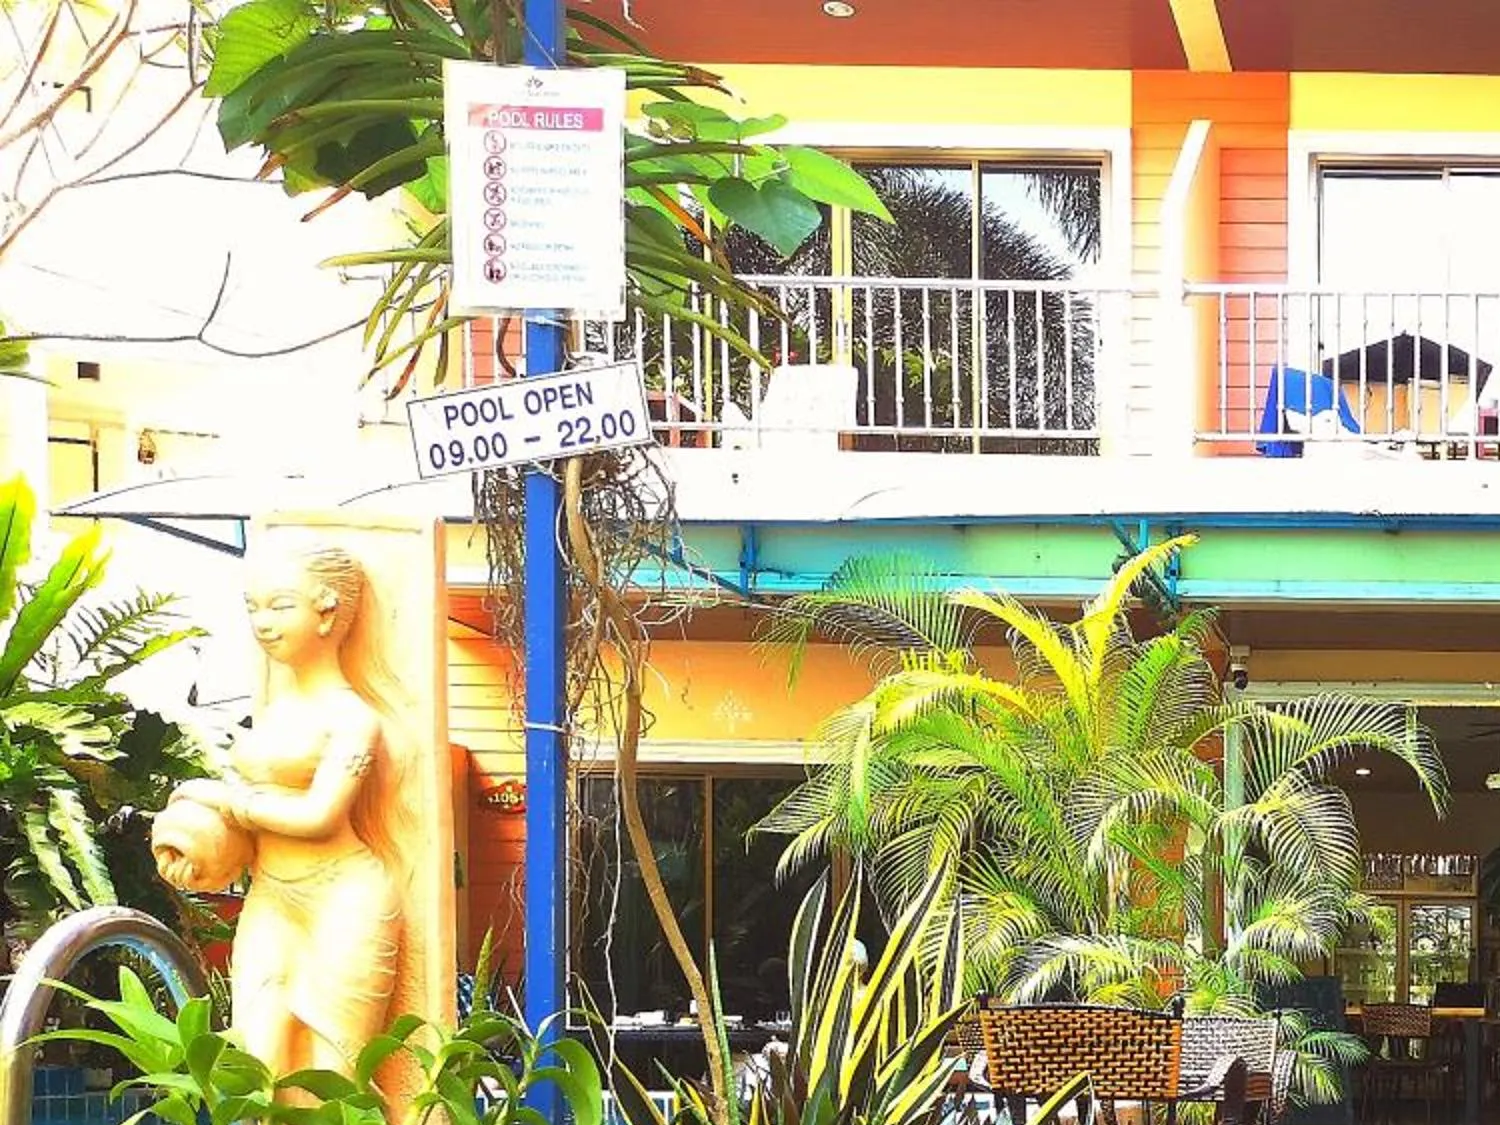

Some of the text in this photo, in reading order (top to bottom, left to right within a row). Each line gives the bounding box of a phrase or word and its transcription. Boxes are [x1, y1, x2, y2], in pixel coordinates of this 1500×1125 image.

[487, 110, 584, 129] POOL RULES
[444, 382, 593, 430] POOL OPEN
[429, 432, 507, 469] 09.00
